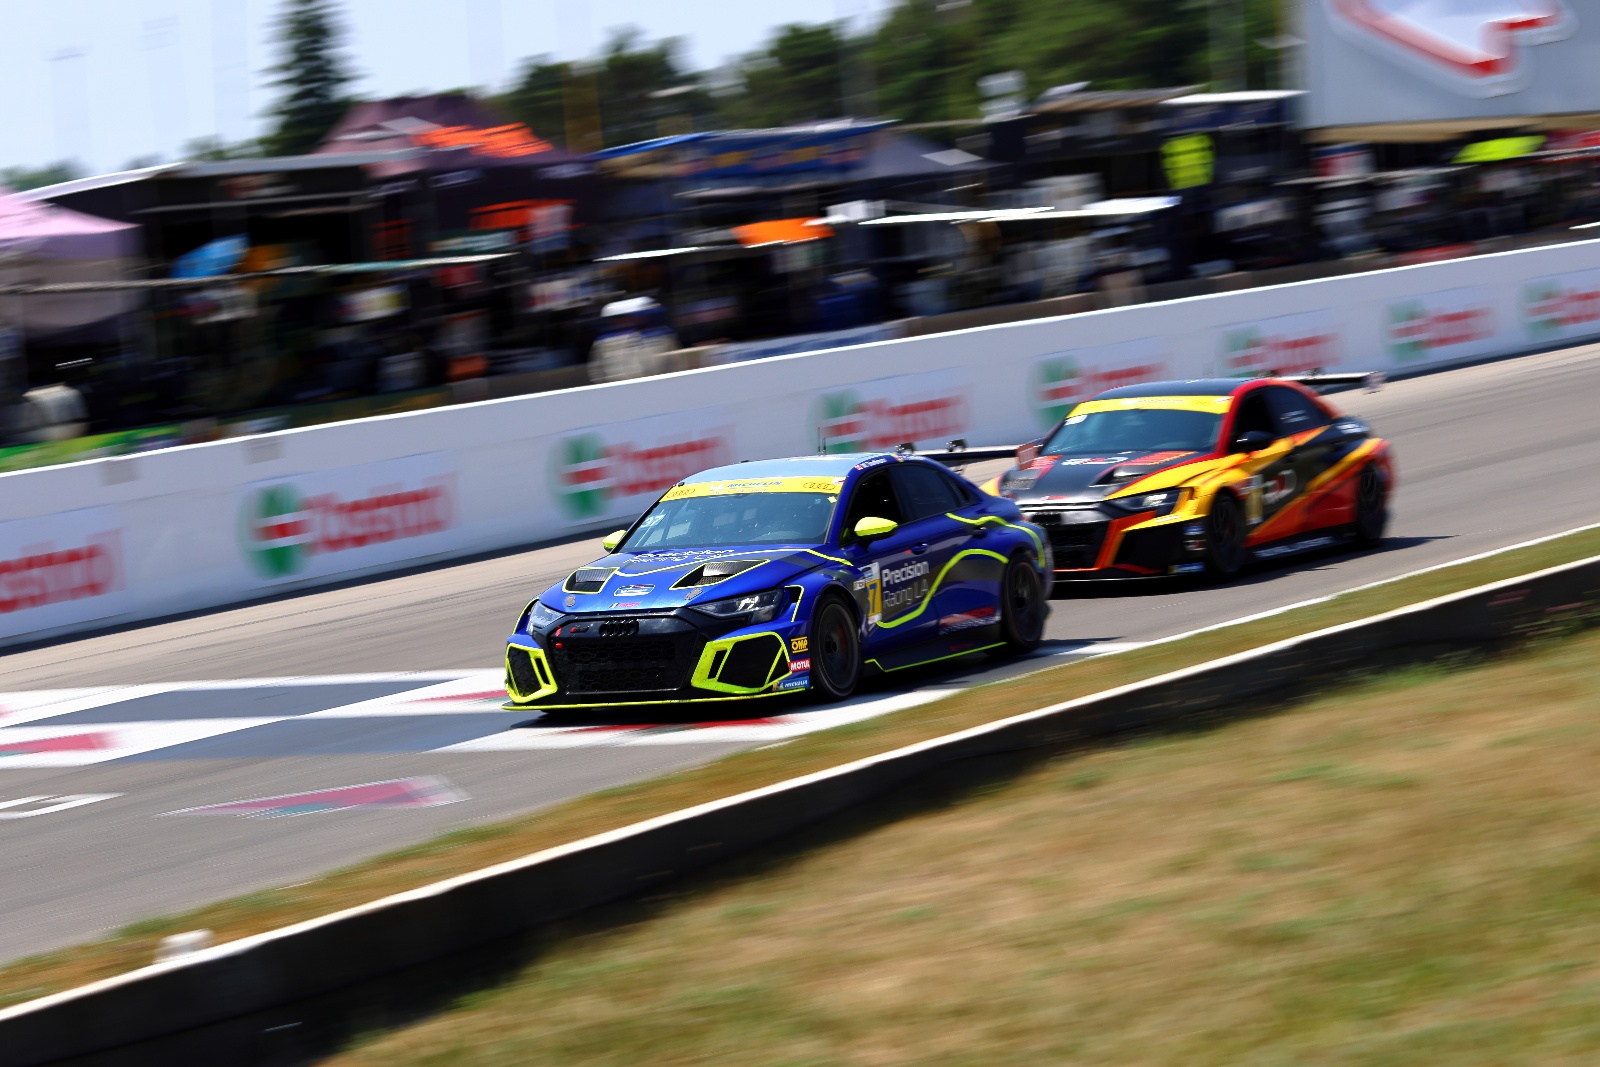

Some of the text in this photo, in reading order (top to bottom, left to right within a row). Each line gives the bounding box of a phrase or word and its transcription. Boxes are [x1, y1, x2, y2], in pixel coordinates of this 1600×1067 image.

[881, 560, 930, 588] Precision
[883, 578, 929, 609] Racing LA
[791, 639, 808, 651] OMP
[790, 659, 810, 671] MOTUL
